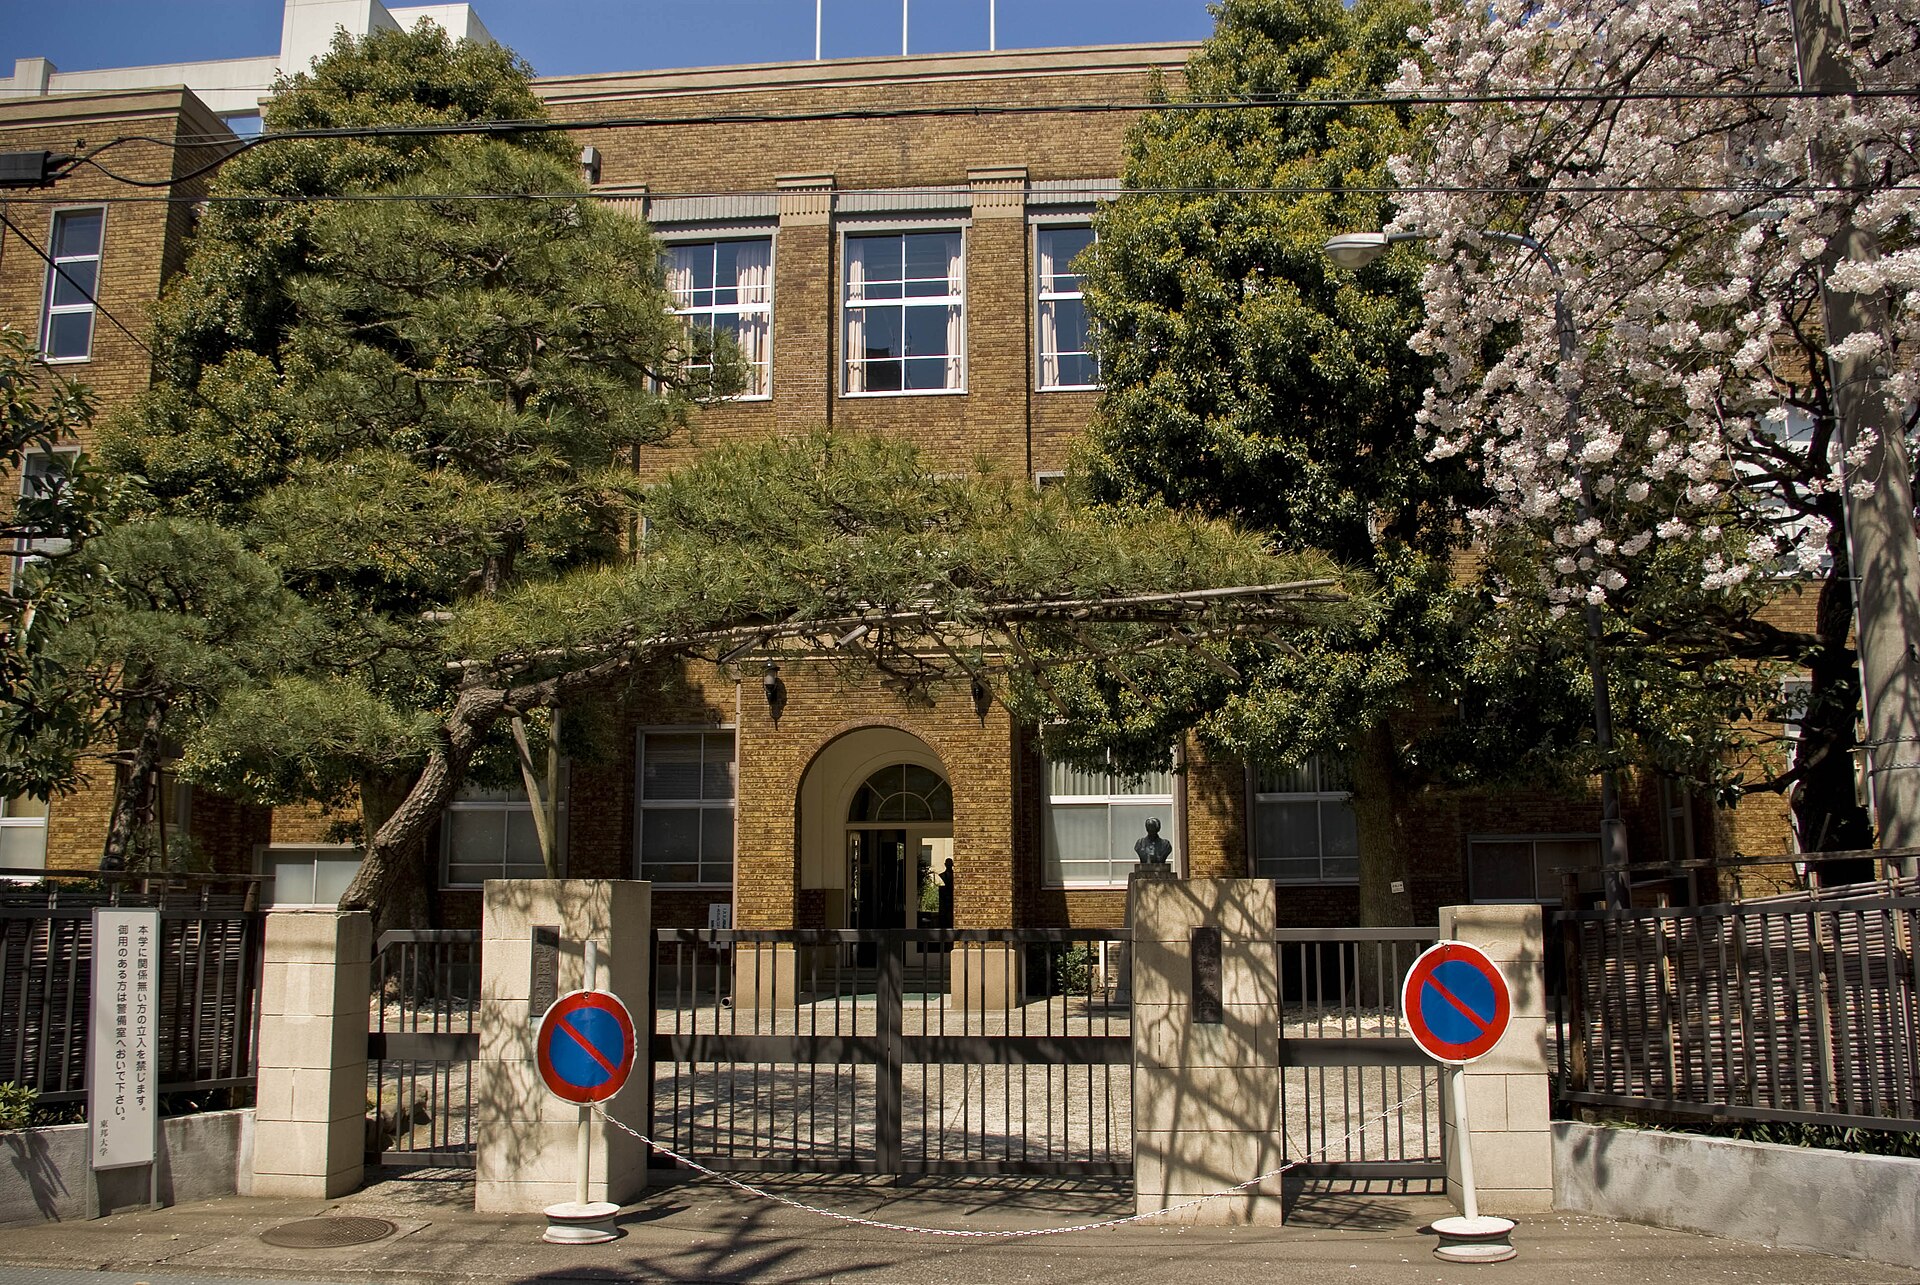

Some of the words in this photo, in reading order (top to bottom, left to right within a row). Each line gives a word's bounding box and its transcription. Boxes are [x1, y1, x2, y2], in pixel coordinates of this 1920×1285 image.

[116, 925, 129, 1120] 御用のある方は警備室へおいで下さい。
[136, 925, 149, 1111] 本学に関係無い方の立入を禁じます。
